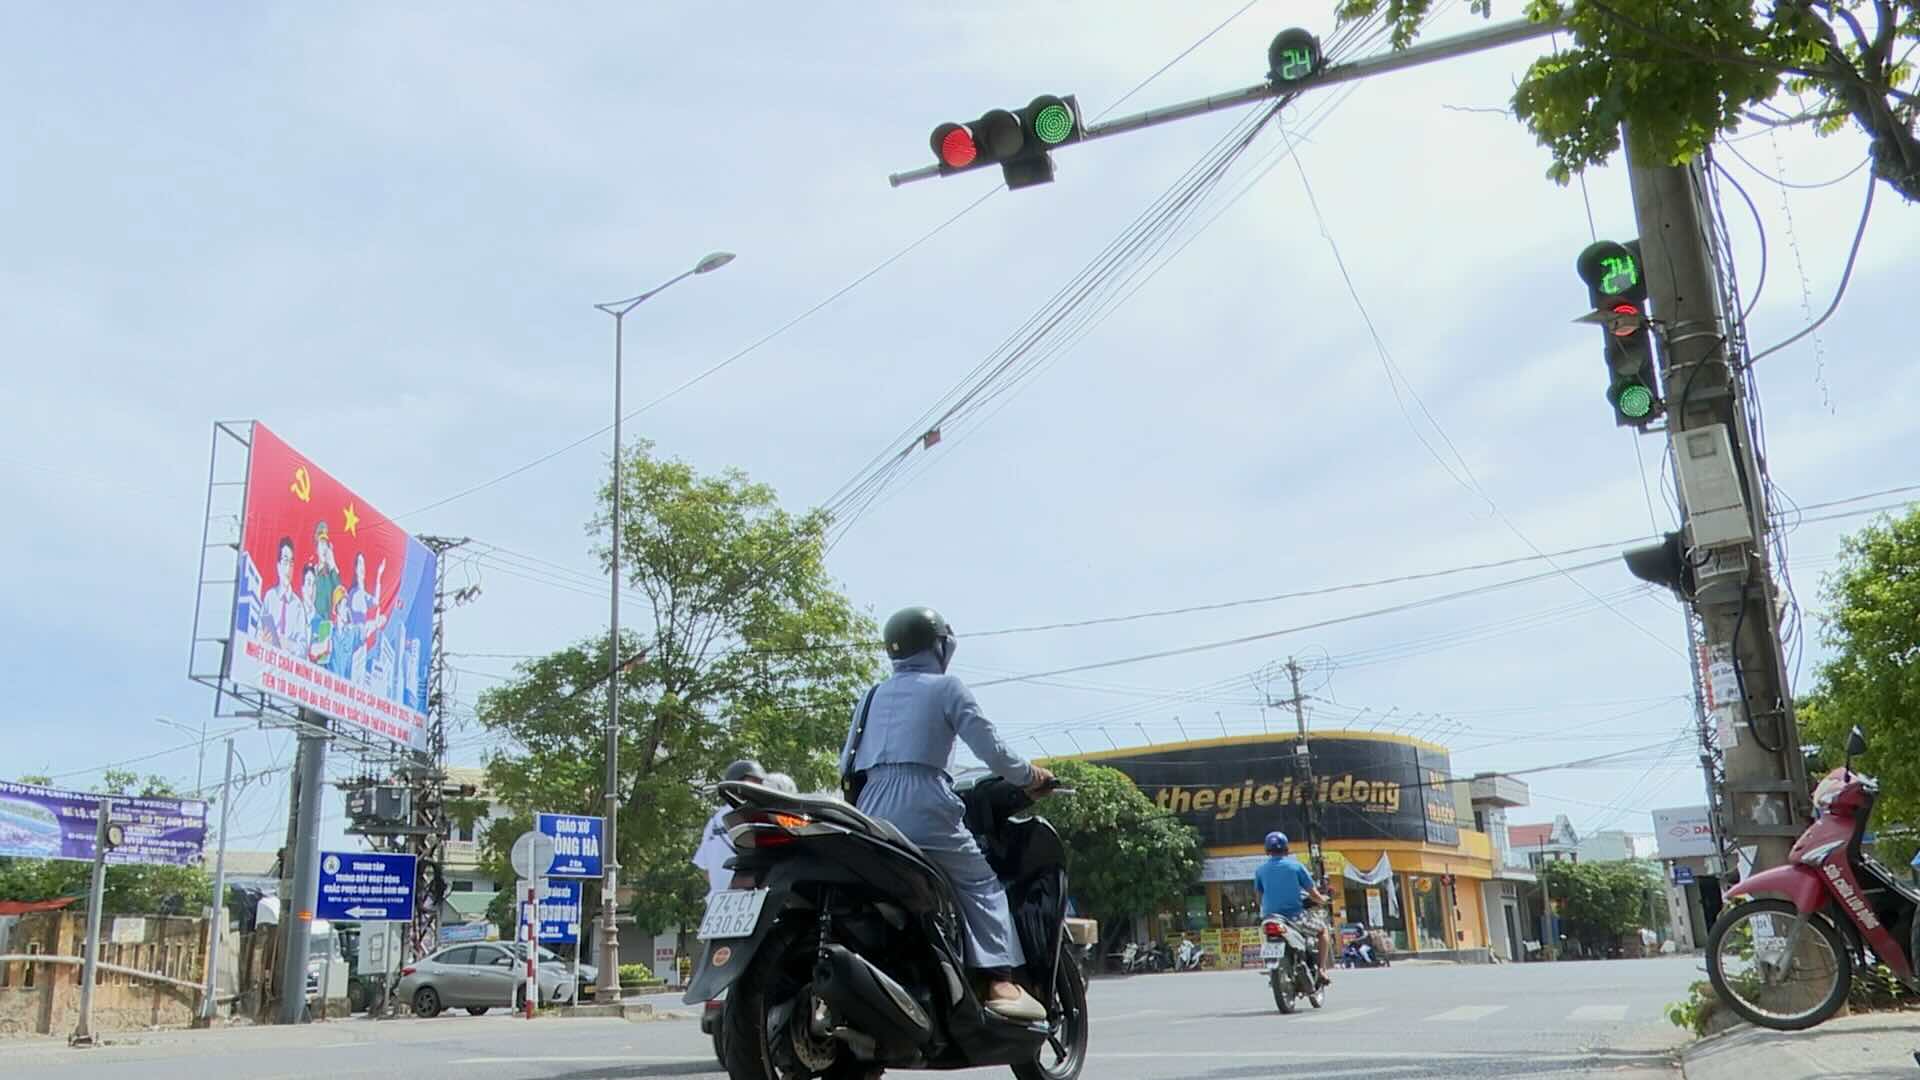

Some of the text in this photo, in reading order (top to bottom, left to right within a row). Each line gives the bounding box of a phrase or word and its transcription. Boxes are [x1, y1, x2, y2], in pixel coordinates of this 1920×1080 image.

[1282, 49, 1312, 80] 24
[1600, 255, 1637, 295] 24
[556, 818, 590, 833] GIÁO XỨ
[582, 834, 599, 857] HÀ
